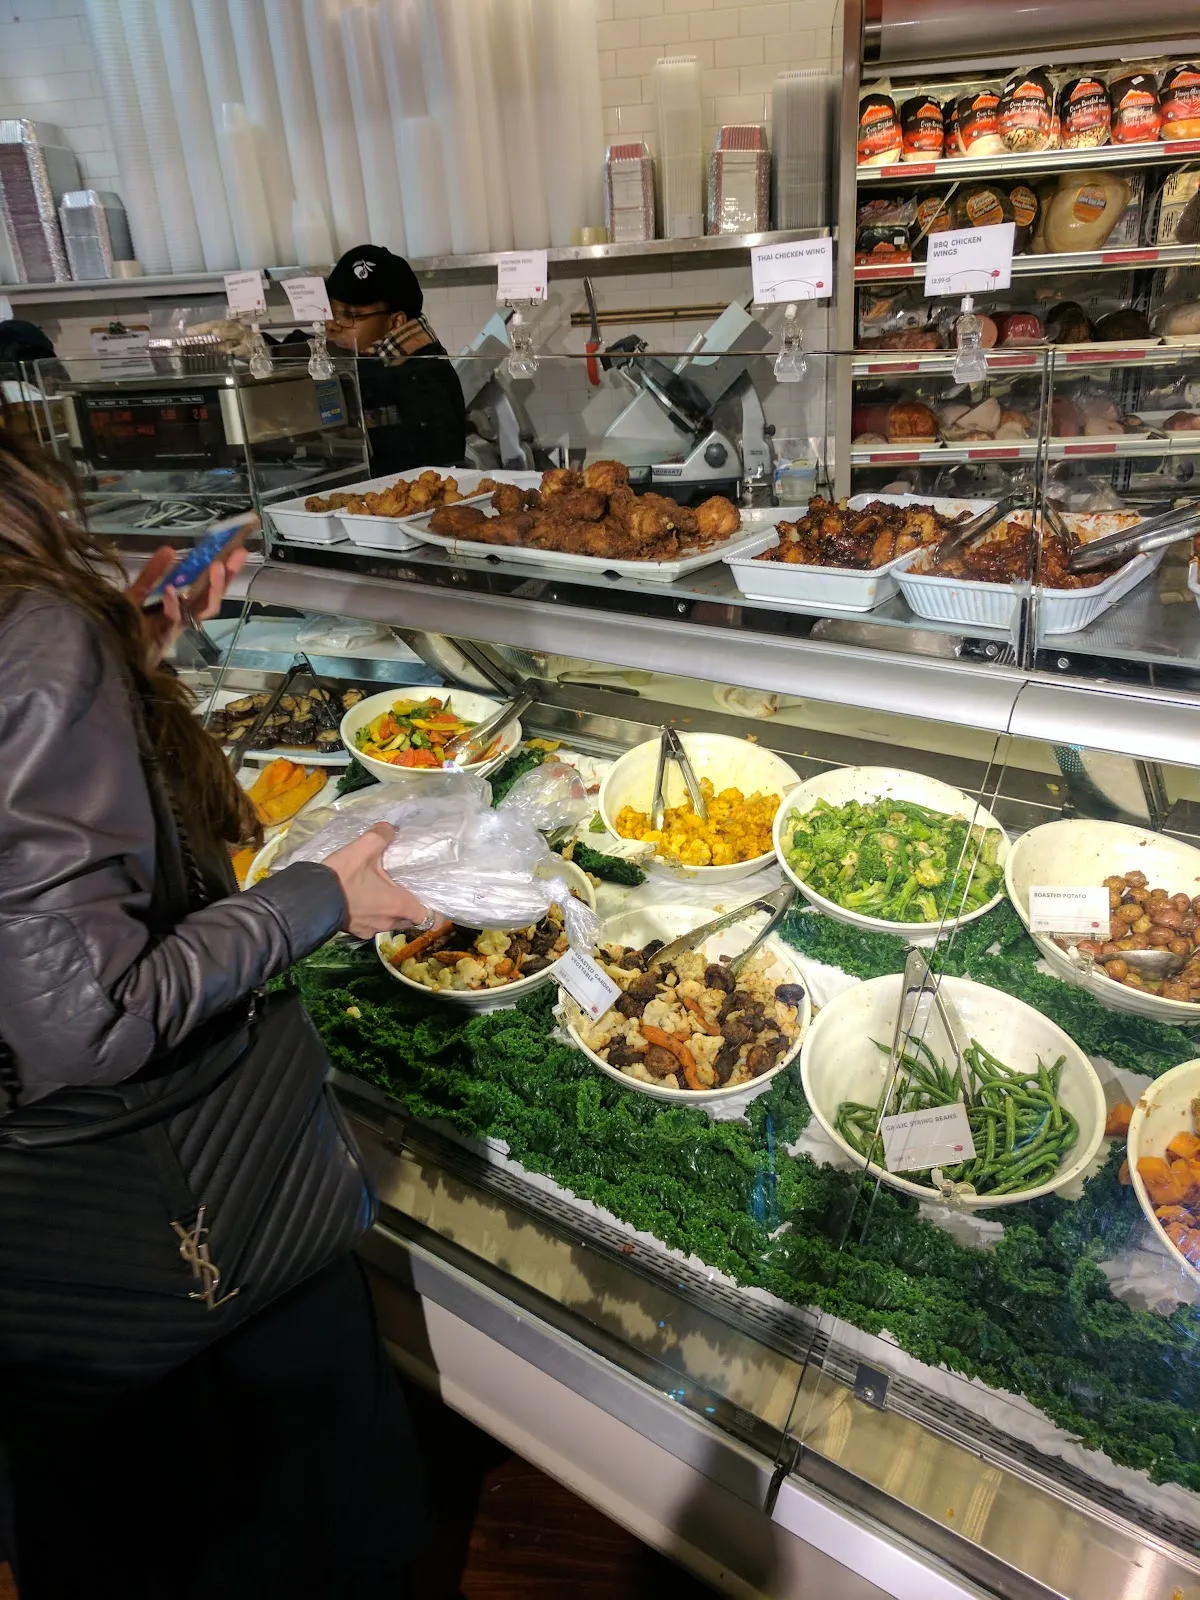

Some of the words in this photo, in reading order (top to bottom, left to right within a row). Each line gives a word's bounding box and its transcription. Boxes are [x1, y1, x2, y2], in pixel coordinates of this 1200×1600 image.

[933, 240, 949, 249] BBQ
[951, 236, 982, 247] CHICKEN
[775, 250, 804, 260] CHICKEN
[805, 247, 826, 256] WING
[933, 248, 958, 258] WINGS
[570, 956, 595, 982] VEGETABLE
[574, 952, 595, 973] ROASTED
[594, 974, 612, 994] GARDEN
[909, 1117, 934, 1127] STRING
[935, 1113, 957, 1122] BEANS
